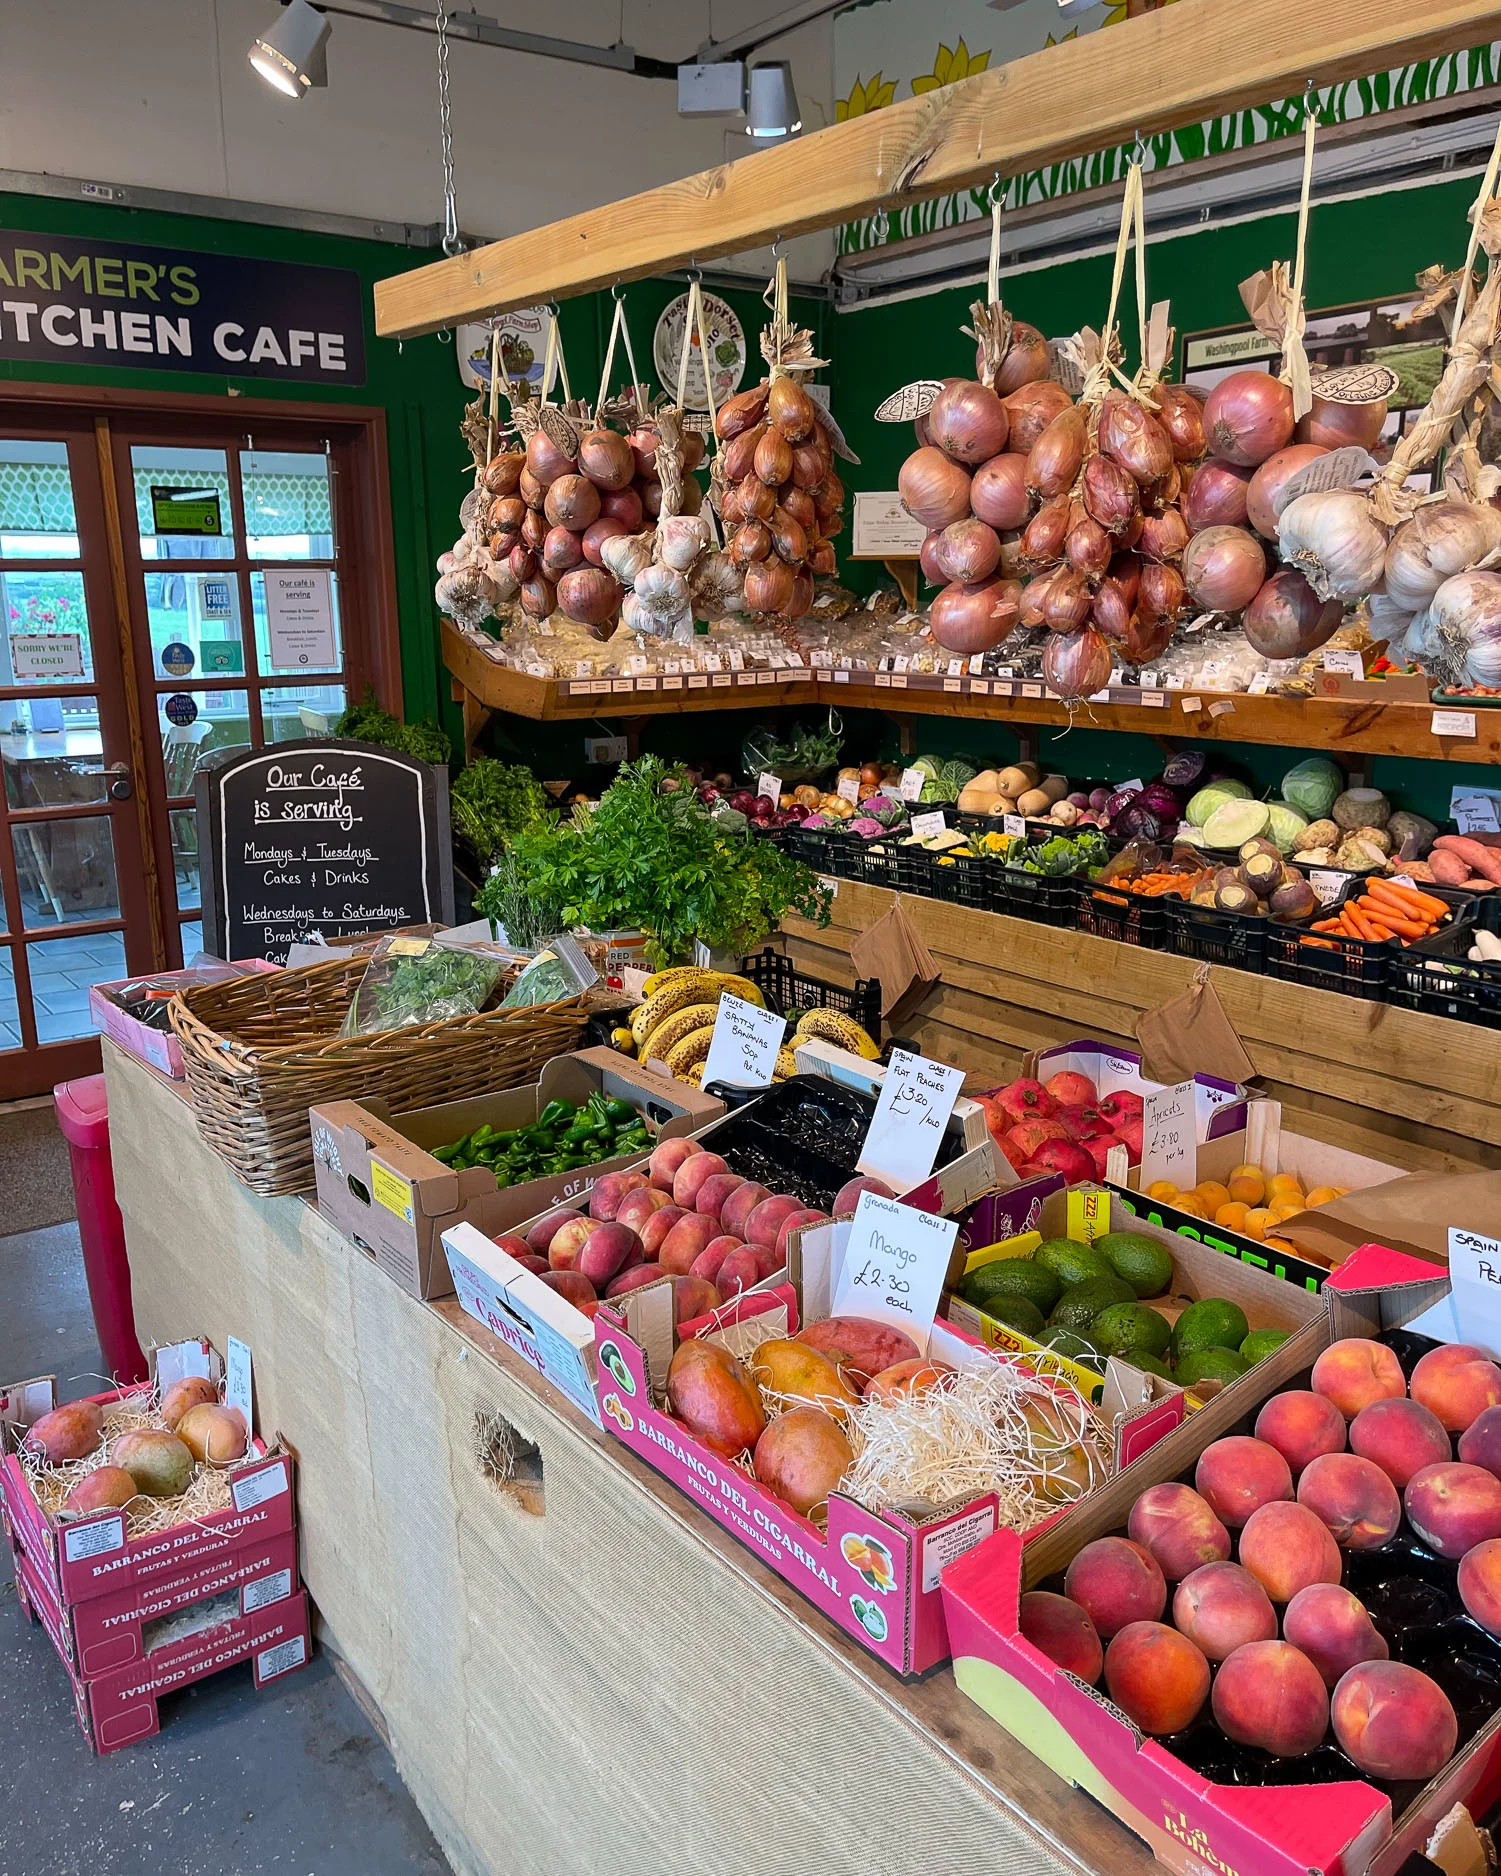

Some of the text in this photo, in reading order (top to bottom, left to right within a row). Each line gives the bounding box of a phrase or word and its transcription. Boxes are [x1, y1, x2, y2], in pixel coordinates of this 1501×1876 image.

[0, 248, 200, 306] ARMER'S
[663, 298, 741, 341] Tast Dorset
[0, 301, 347, 371] TCHEN CAFE
[1205, 336, 1268, 357] Washingpool Farm
[206, 586, 228, 594] LITTER
[207, 594, 228, 604] FREE
[170, 714, 194, 722] GOLD
[267, 765, 302, 788] Our
[254, 800, 354, 831] is serving
[244, 842, 293, 868] Mondays
[316, 843, 372, 867] Tuesdays
[264, 870, 370, 888] Cakes & Drinks
[1314, 884, 1340, 892] SWEDE
[244, 904, 405, 928] Wednesdays to Saturdays
[608, 962, 656, 975] PEPPERS
[610, 952, 630, 960] RED
[757, 1010, 774, 1022] CLASS
[732, 1024, 768, 1049] BANANAS
[756, 1068, 767, 1080] KILO
[894, 1050, 913, 1062] SPAIN
[928, 1064, 946, 1075] CLASS
[894, 1066, 945, 1092] FLAT PEACHES
[889, 1082, 927, 1115] £3.20
[1151, 1100, 1181, 1126] Apricots
[1149, 1131, 1179, 1156] £3.80
[1166, 1151, 1175, 1164] per
[564, 1179, 580, 1197] OF
[1086, 1196, 1096, 1217] ZZ2
[918, 1214, 939, 1230] Class
[869, 1230, 917, 1270] Mango
[1455, 1233, 1498, 1252] SPAIN
[853, 1260, 910, 1293] £2.30
[885, 1296, 913, 1313] each
[476, 1298, 545, 1370] Caprice
[994, 1328, 1020, 1352] ZZ2
[637, 1417, 842, 1598] BARRANCO DEL CIGARRAL
[687, 1474, 782, 1561] FRUTAS Y VERDURAS
[927, 1509, 993, 1544] Barranco del Cigarral
[92, 1542, 170, 1576] BARRANCO
[173, 1532, 200, 1548] DEL
[202, 1510, 268, 1538] CIGARRAL
[136, 1538, 229, 1575] FRUTAS Y VERDURAS
[143, 1559, 233, 1599] FRUTAS Y VERDURAS
[202, 1557, 272, 1593] BARRANCO
[176, 1587, 200, 1604] DEL
[102, 1599, 172, 1629] CIGARRAL
[157, 1629, 246, 1670] FRUTAS Y VERDURAS
[216, 1624, 284, 1662] BARRANCO
[190, 1658, 213, 1674] DEL
[118, 1670, 186, 1701] CIGARRAL
[1180, 1812, 1208, 1845] La
[1164, 1814, 1240, 1876] Bohèm
